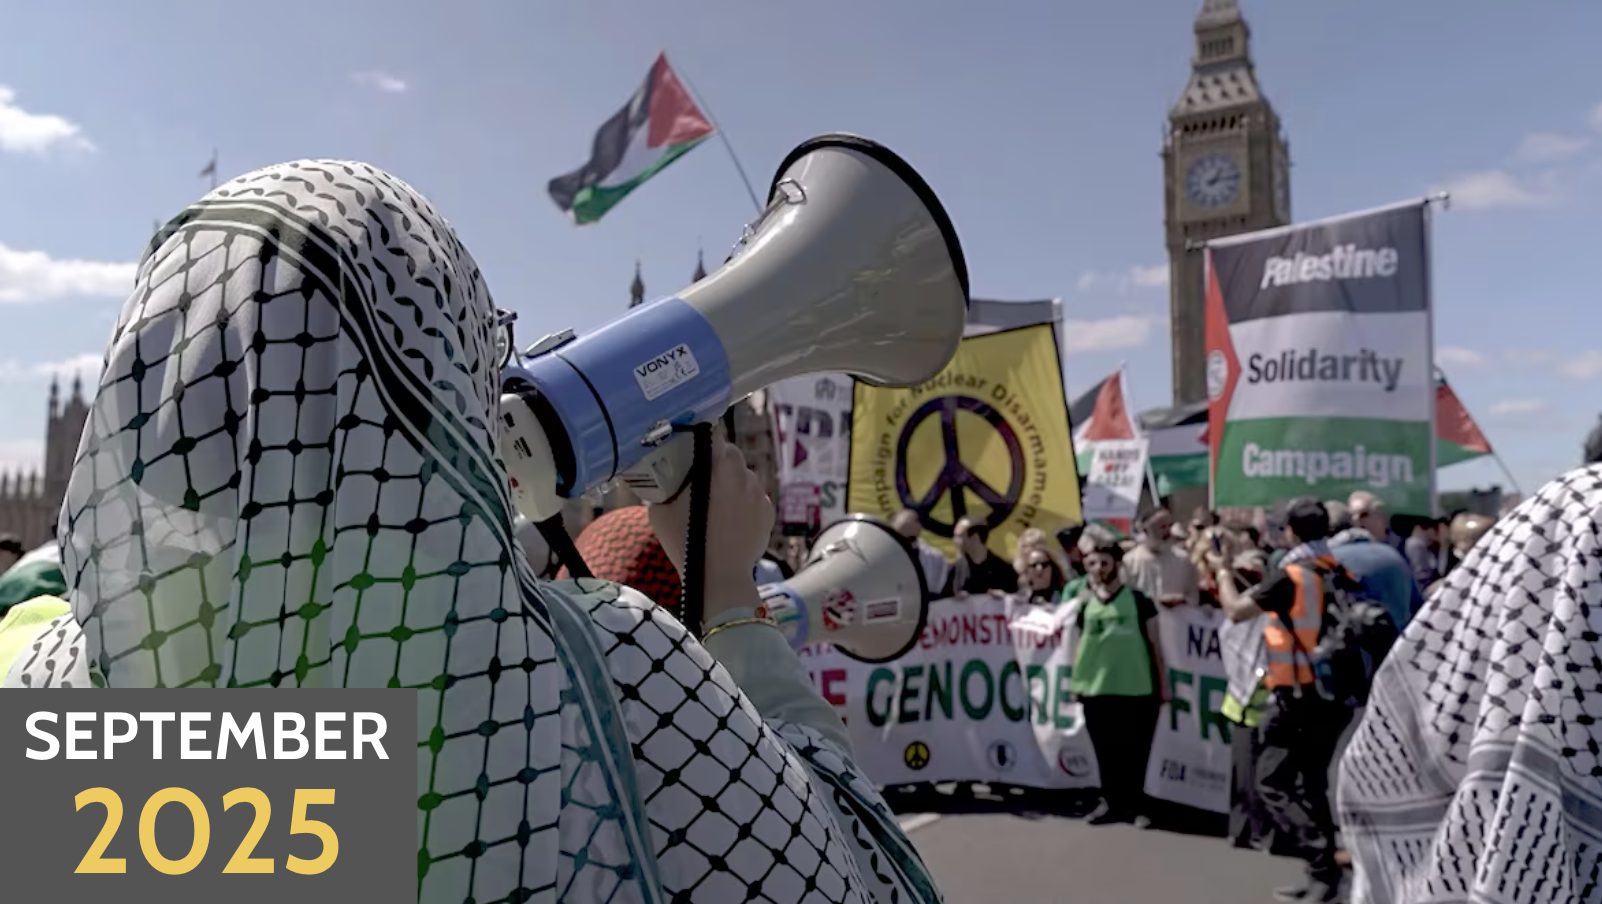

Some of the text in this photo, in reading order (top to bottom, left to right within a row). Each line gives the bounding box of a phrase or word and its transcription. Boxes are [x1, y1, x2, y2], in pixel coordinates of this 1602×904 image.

[1260, 243, 1398, 289] Palestine
[636, 346, 687, 377] VONYX
[1248, 348, 1404, 392] Solidarity
[872, 432, 894, 519] mpaign
[887, 398, 908, 429] for
[909, 372, 988, 400] Nuclear
[991, 382, 1049, 528] Disarmament
[1243, 442, 1413, 486] Campaign
